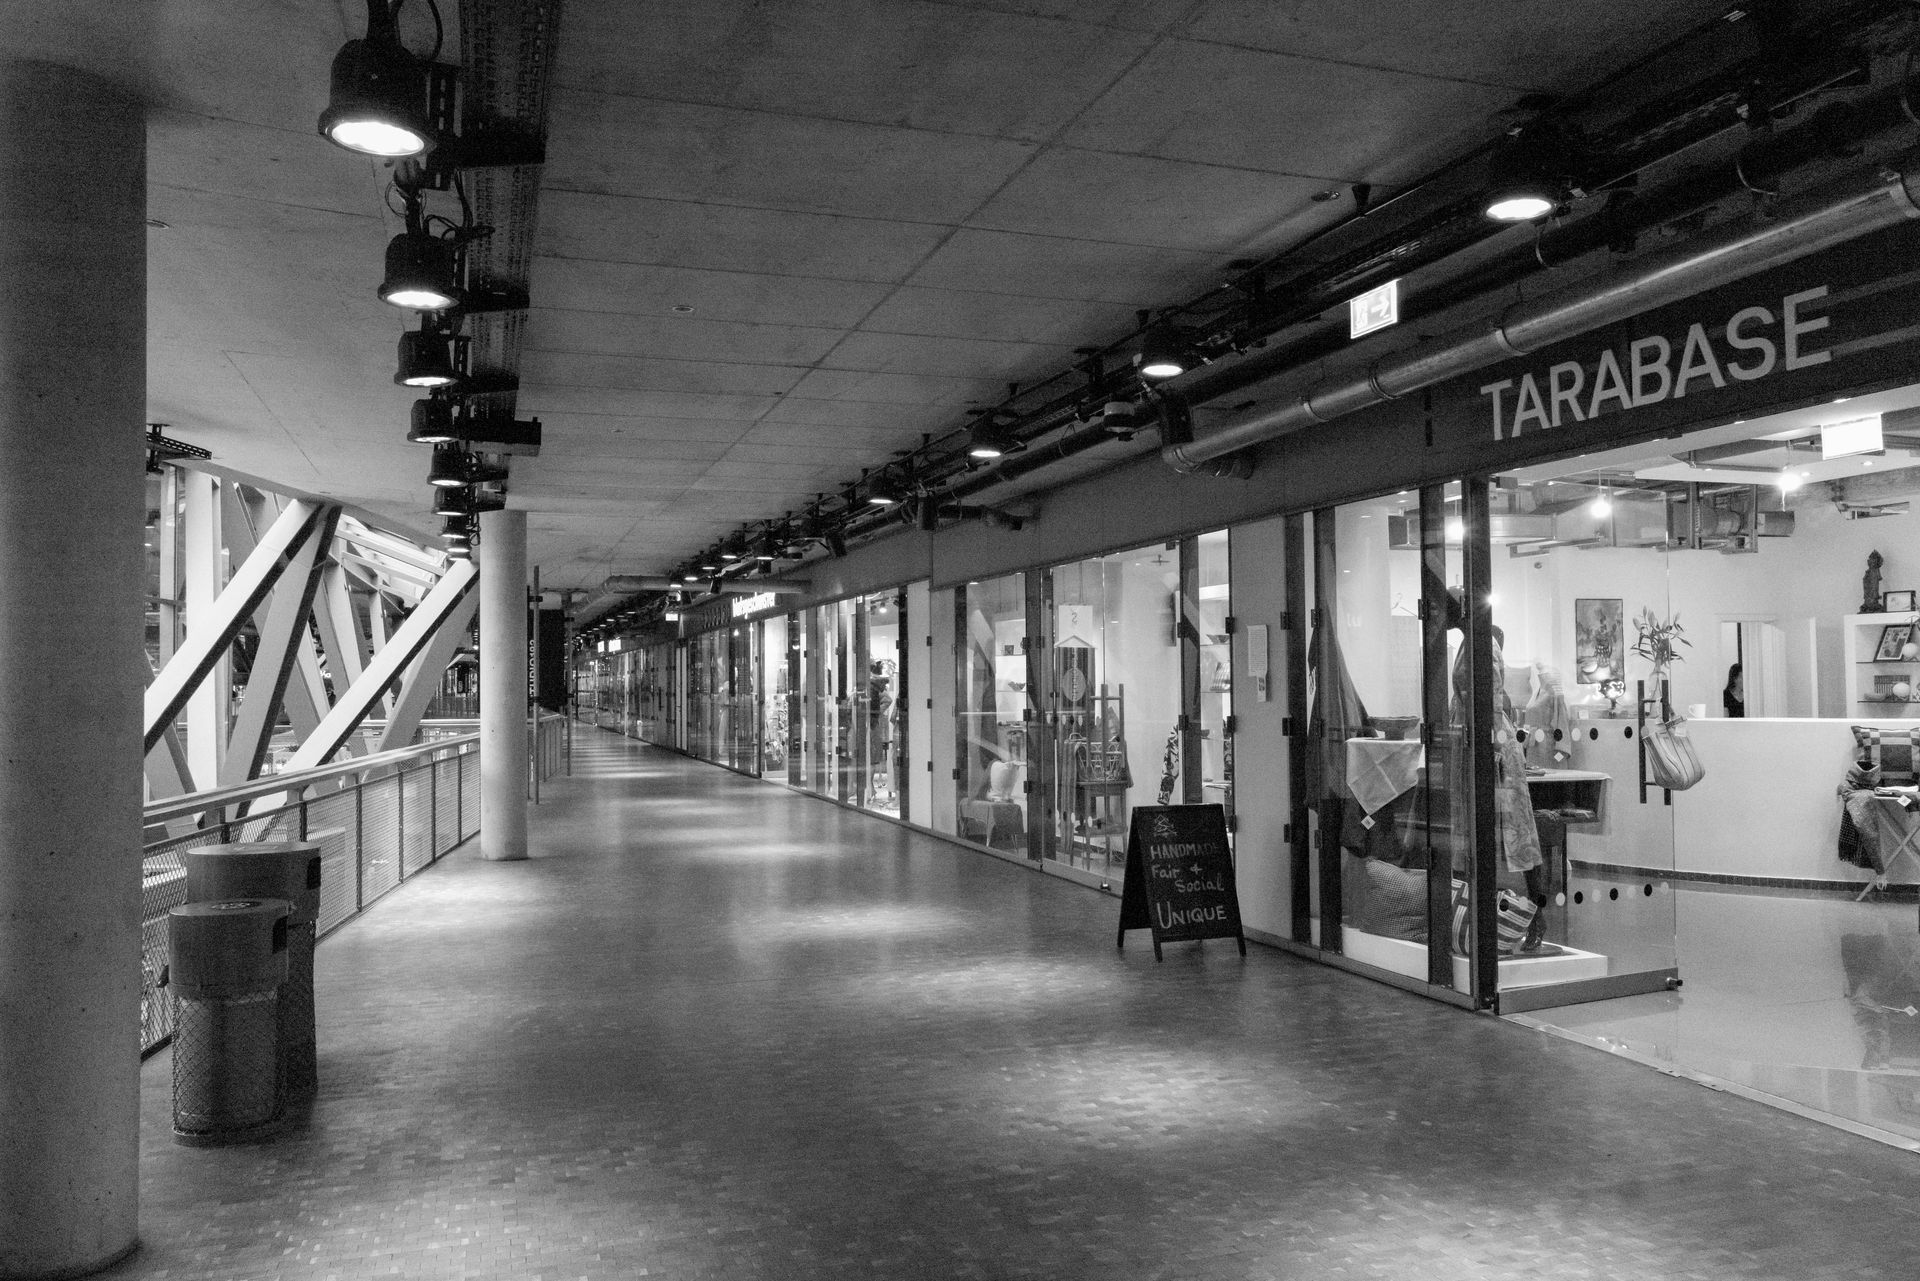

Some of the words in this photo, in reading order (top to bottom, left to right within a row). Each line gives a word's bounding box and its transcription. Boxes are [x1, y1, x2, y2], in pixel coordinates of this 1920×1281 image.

[1480, 285, 1832, 441] TARABASE
[1151, 864, 1180, 879] Fair
[1174, 871, 1225, 893] Social
